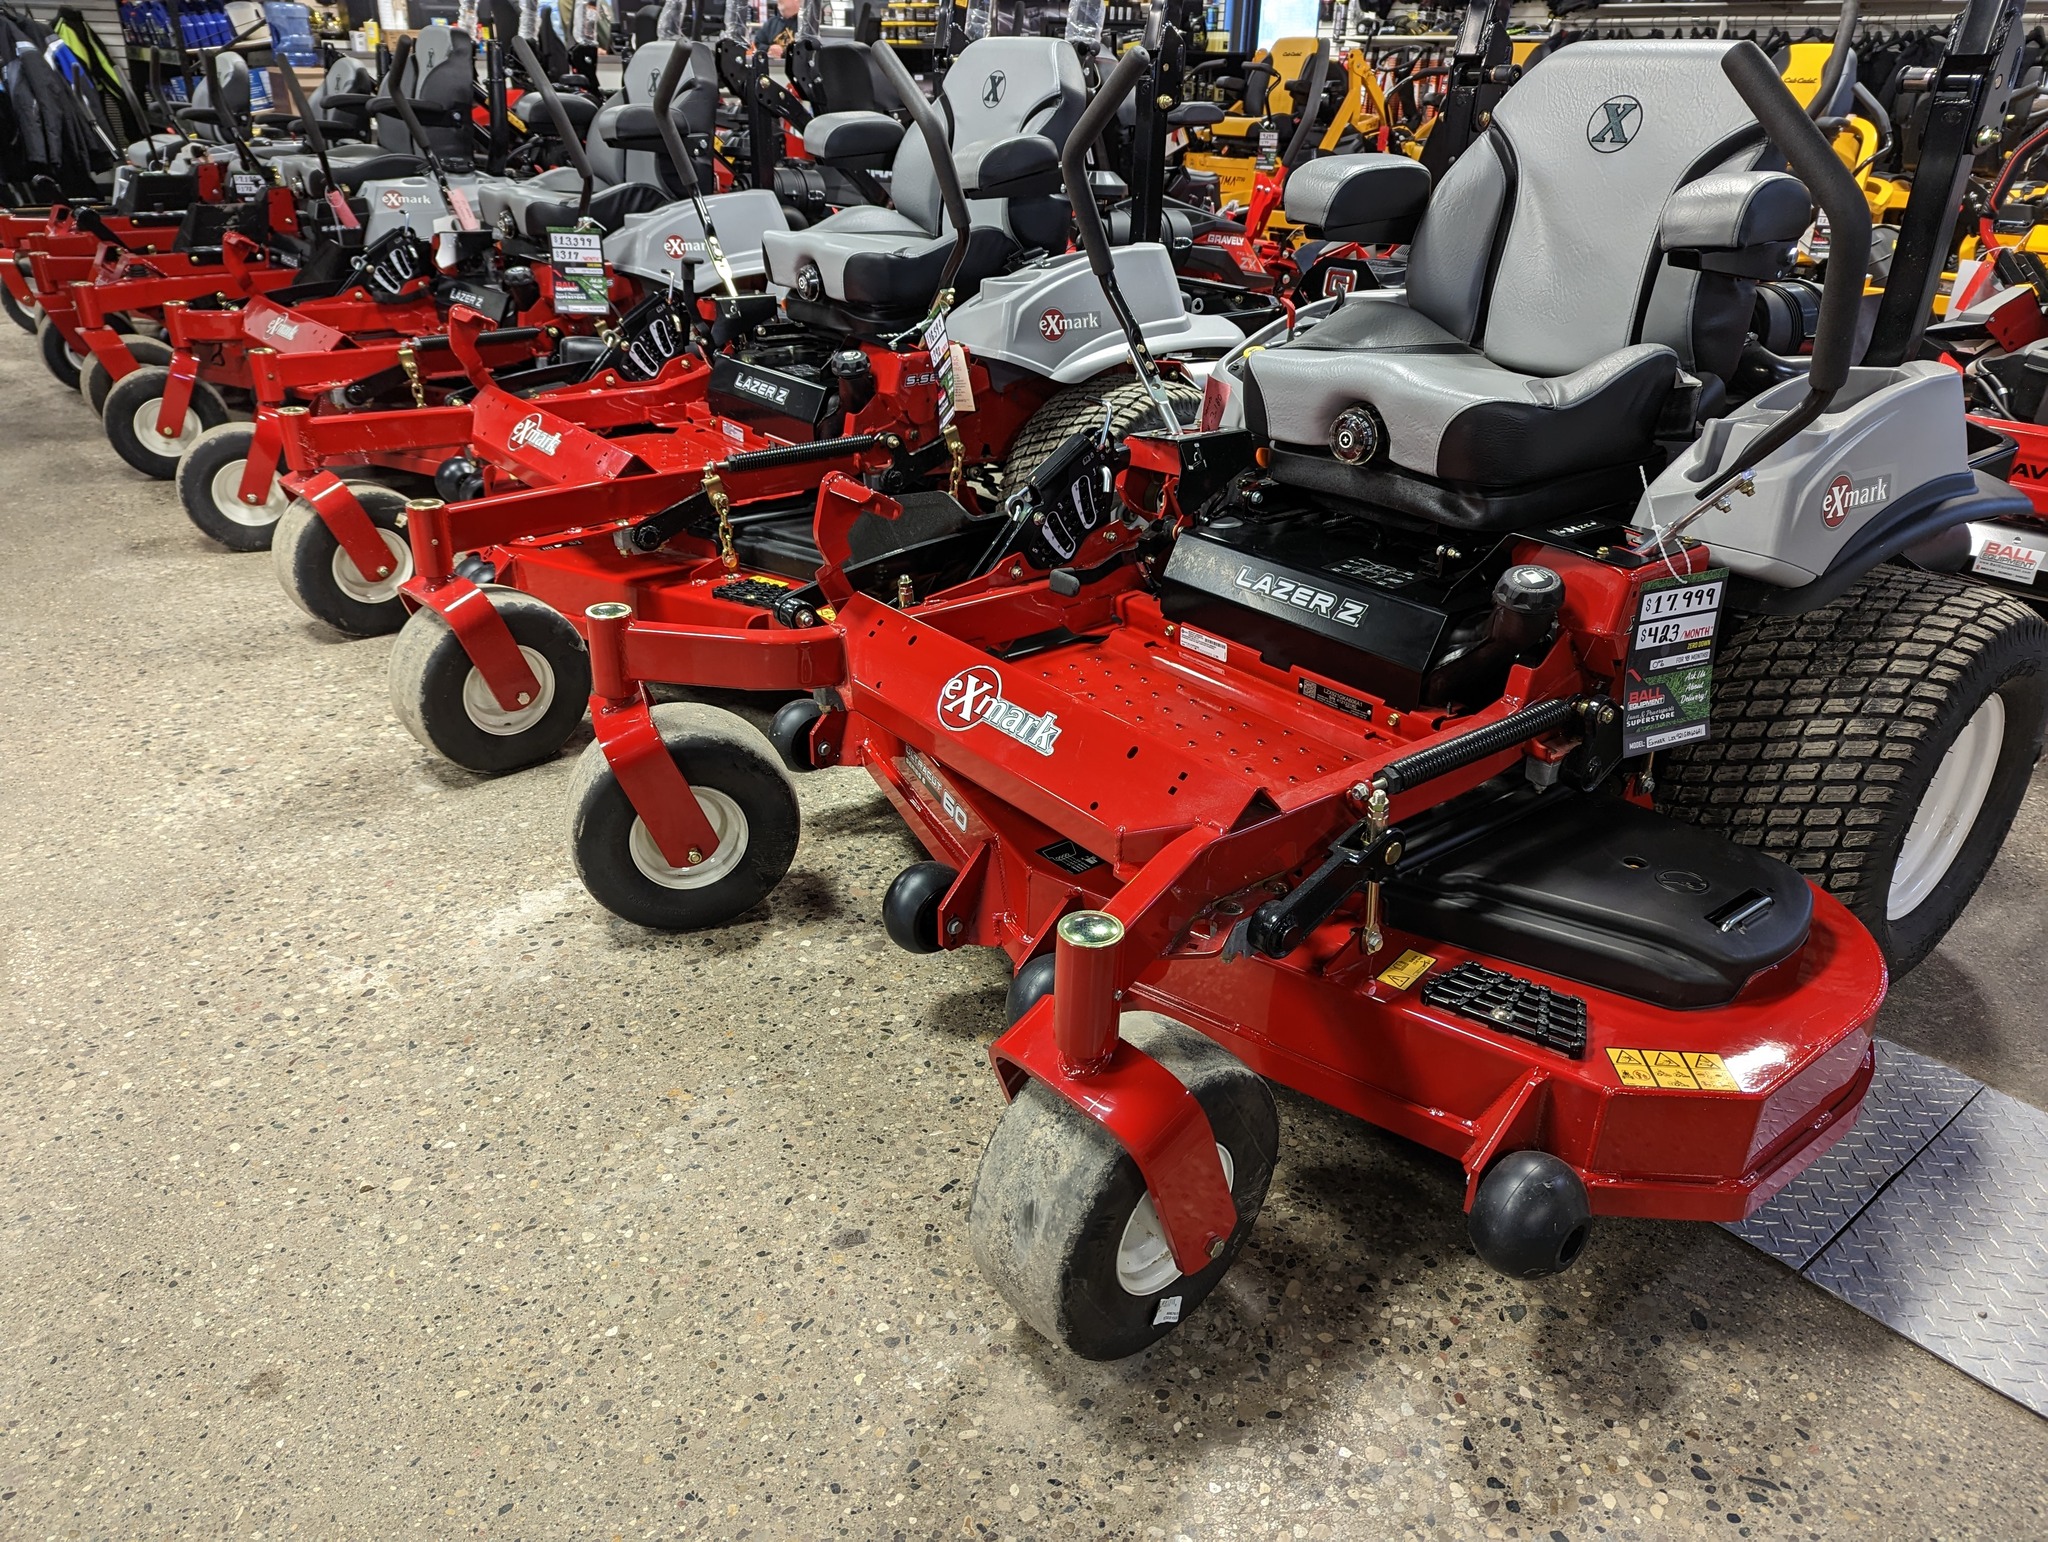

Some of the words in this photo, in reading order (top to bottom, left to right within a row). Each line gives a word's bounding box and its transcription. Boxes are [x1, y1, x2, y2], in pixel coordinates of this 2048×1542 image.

[983, 75, 1004, 102] X
[1591, 103, 1638, 143] X
[381, 192, 431, 206] eXmark
[663, 238, 706, 255] eXmar
[1207, 233, 1245, 246] GRAVELY
[450, 288, 477, 304] LAZER
[475, 296, 484, 307] Z
[1039, 312, 1099, 336] eXmark
[734, 372, 777, 400] LAZER
[774, 387, 790, 405] Z
[510, 418, 562, 455] eXmark
[1822, 476, 1888, 519] eXmark
[1981, 552, 2036, 570] EQUIPMENT
[1985, 541, 2037, 563] BALL
[1235, 567, 1337, 617] LAZER
[1333, 599, 1368, 627] Z
[1684, 670, 1697, 681] Ask
[1628, 686, 1664, 703] BALL
[1685, 681, 1704, 693] About
[1628, 697, 1665, 710] EQUIPMENT
[1680, 690, 1708, 705] Delivery!
[943, 674, 1060, 752] eXmark
[1626, 711, 1675, 728] SUPERSTORE
[1629, 740, 1646, 750] MODEL:
[942, 788, 967, 833] 60
